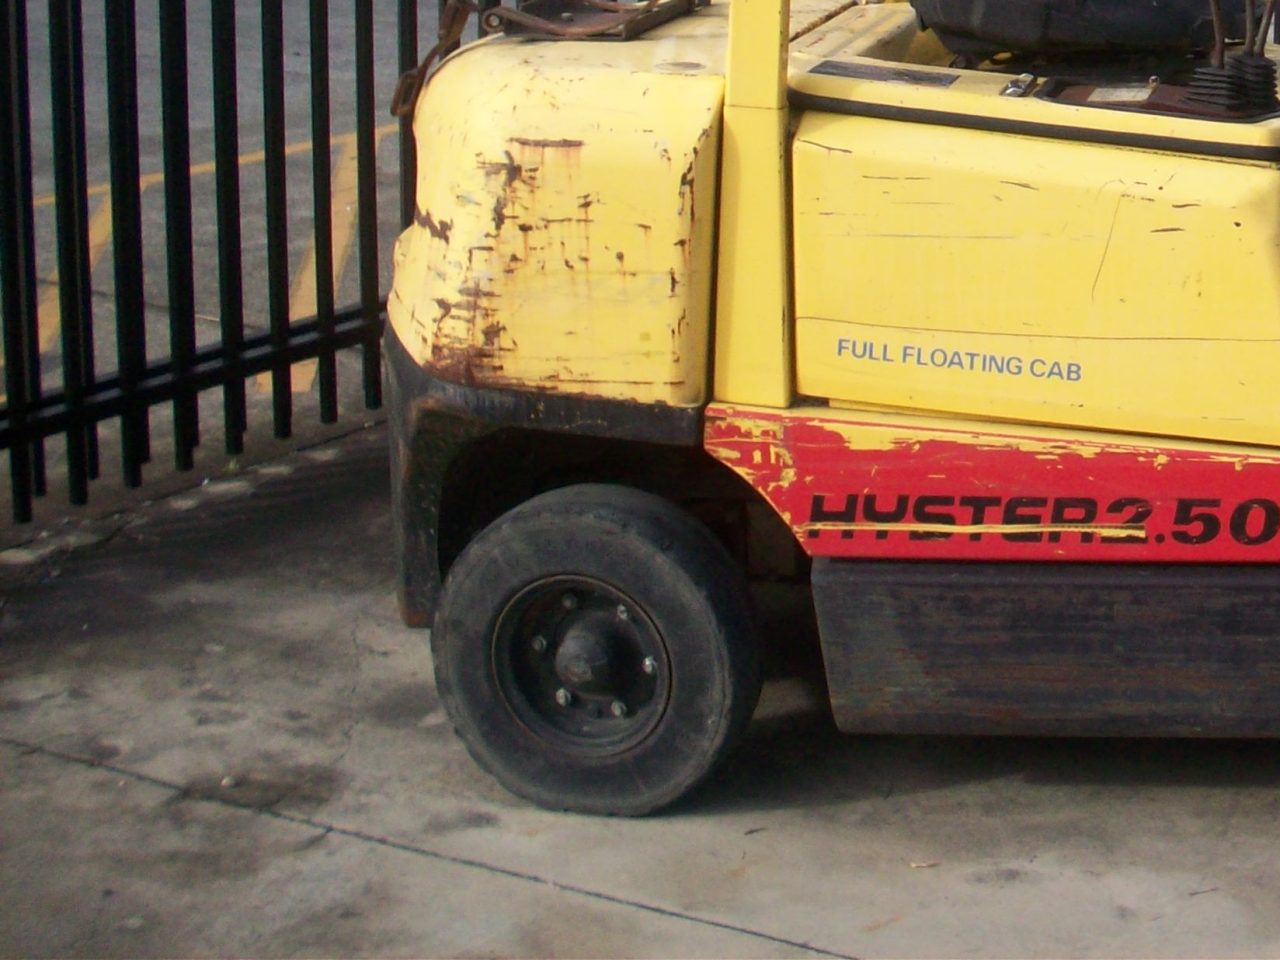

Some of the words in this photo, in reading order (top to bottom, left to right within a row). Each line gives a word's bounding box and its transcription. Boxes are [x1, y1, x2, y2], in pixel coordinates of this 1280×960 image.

[837, 338, 894, 363] FULL
[901, 345, 1023, 376] FLOATING
[1029, 358, 1083, 383] CAB
